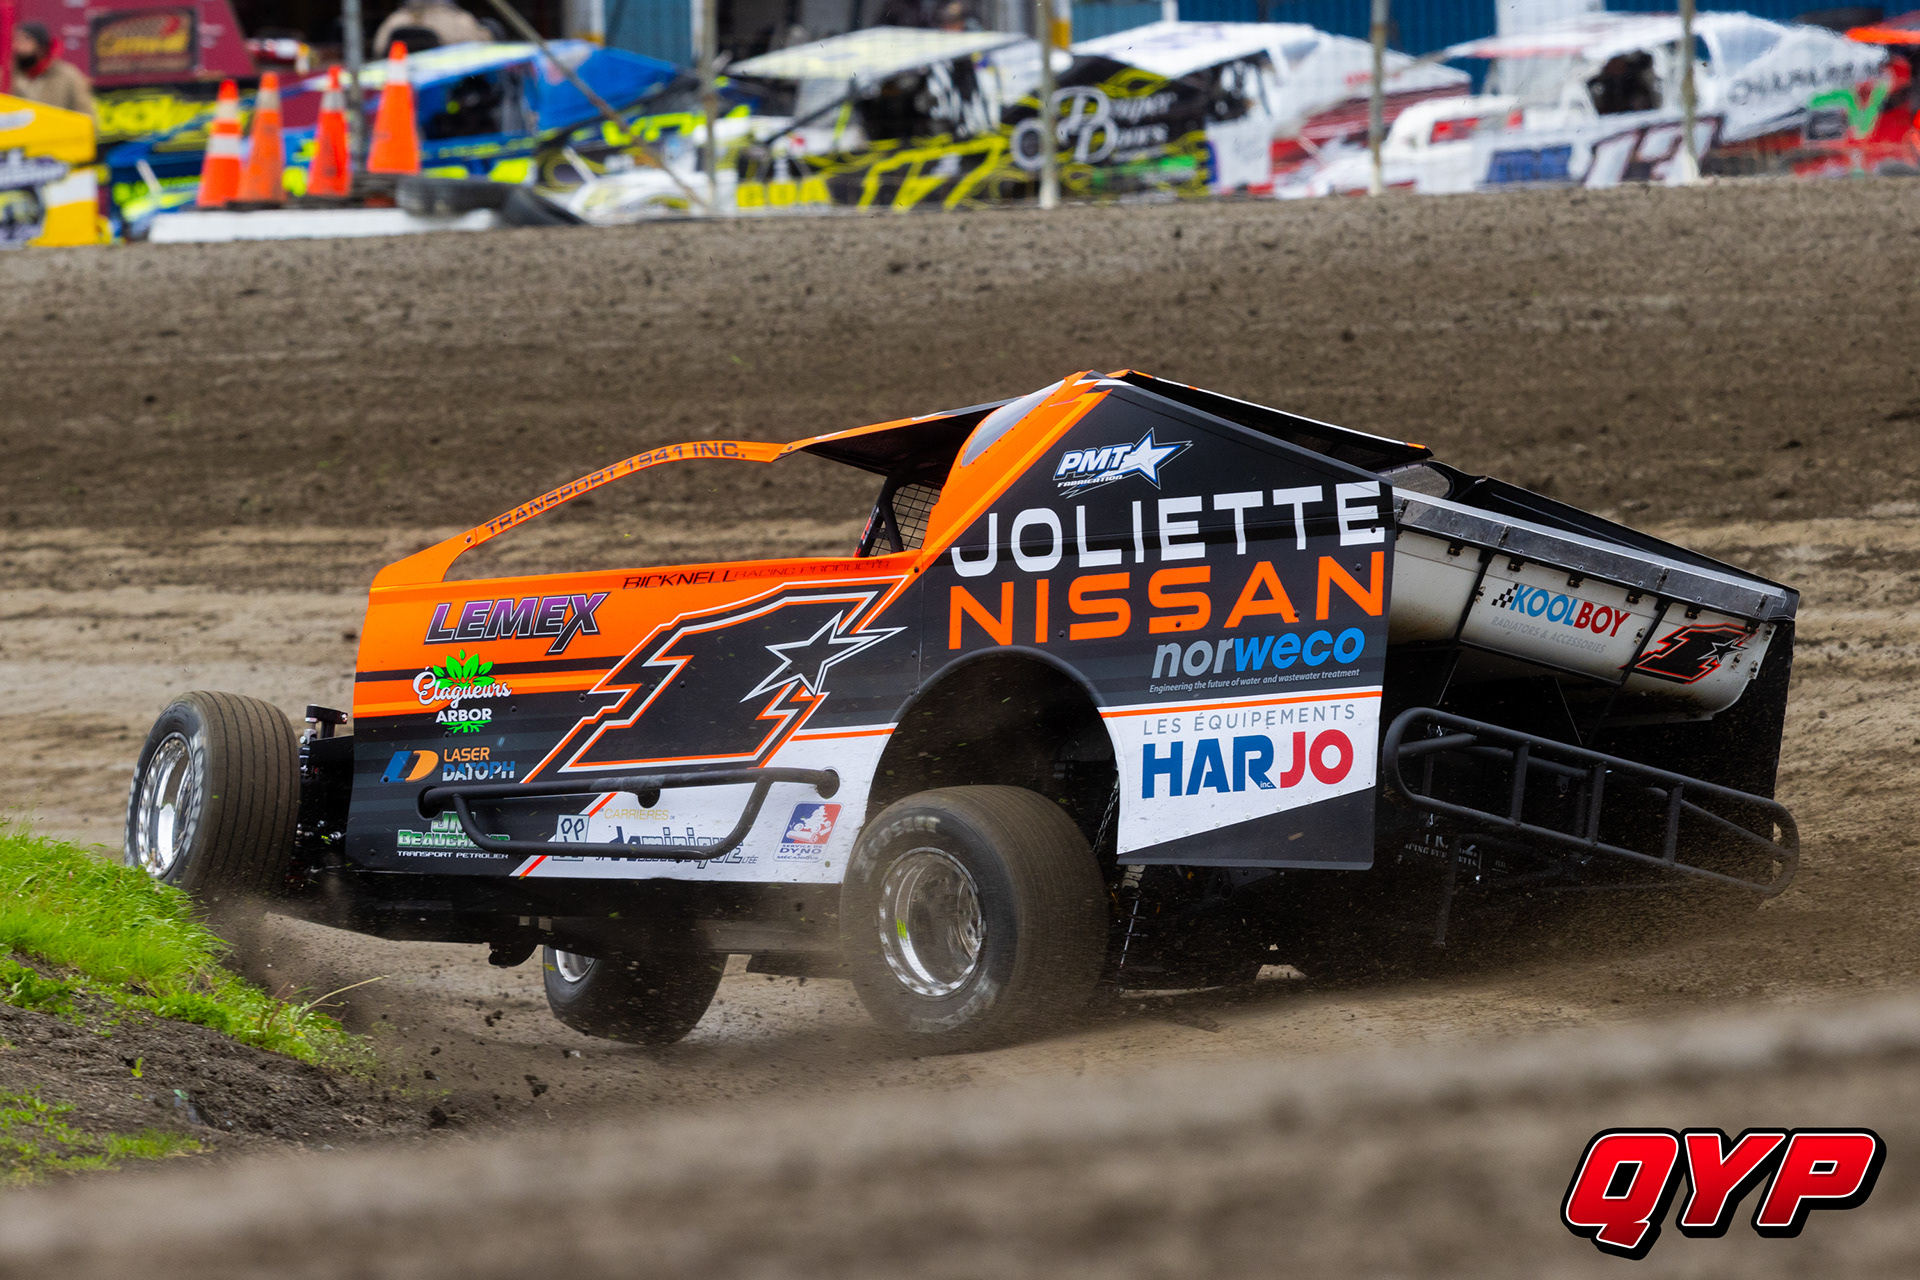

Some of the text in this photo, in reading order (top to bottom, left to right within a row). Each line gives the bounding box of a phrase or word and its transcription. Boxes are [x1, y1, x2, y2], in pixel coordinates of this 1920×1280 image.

[485, 443, 746, 534] TRANSPORT 1941 INC.
[1057, 475, 1123, 487] FABRICATION
[950, 481, 1385, 577] JOLIETTE
[623, 560, 889, 589] BICKNELL RACING PRODUCTS
[949, 551, 1385, 649] NISSAN
[1509, 584, 1631, 638] KOOLBOY
[424, 592, 611, 656] LEMEX
[1490, 616, 1539, 637] RADIATORS
[1550, 632, 1606, 653] ACCESSORIES
[1152, 628, 1365, 678] norweco
[413, 667, 512, 709] Élagueurs
[1149, 679, 1193, 694] Engineering
[1194, 679, 1206, 690] the
[1207, 678, 1230, 688] future
[1231, 676, 1239, 686] of
[1263, 675, 1278, 684] and
[1278, 672, 1320, 682] wastewater
[1321, 668, 1360, 680] treatment
[435, 708, 492, 723] ARBOR
[1144, 704, 1355, 735] LES ÉQUIPEMENTS
[442, 761, 515, 781] DATOPH
[444, 747, 490, 761] LASER
[1142, 729, 1354, 798] HARJO
